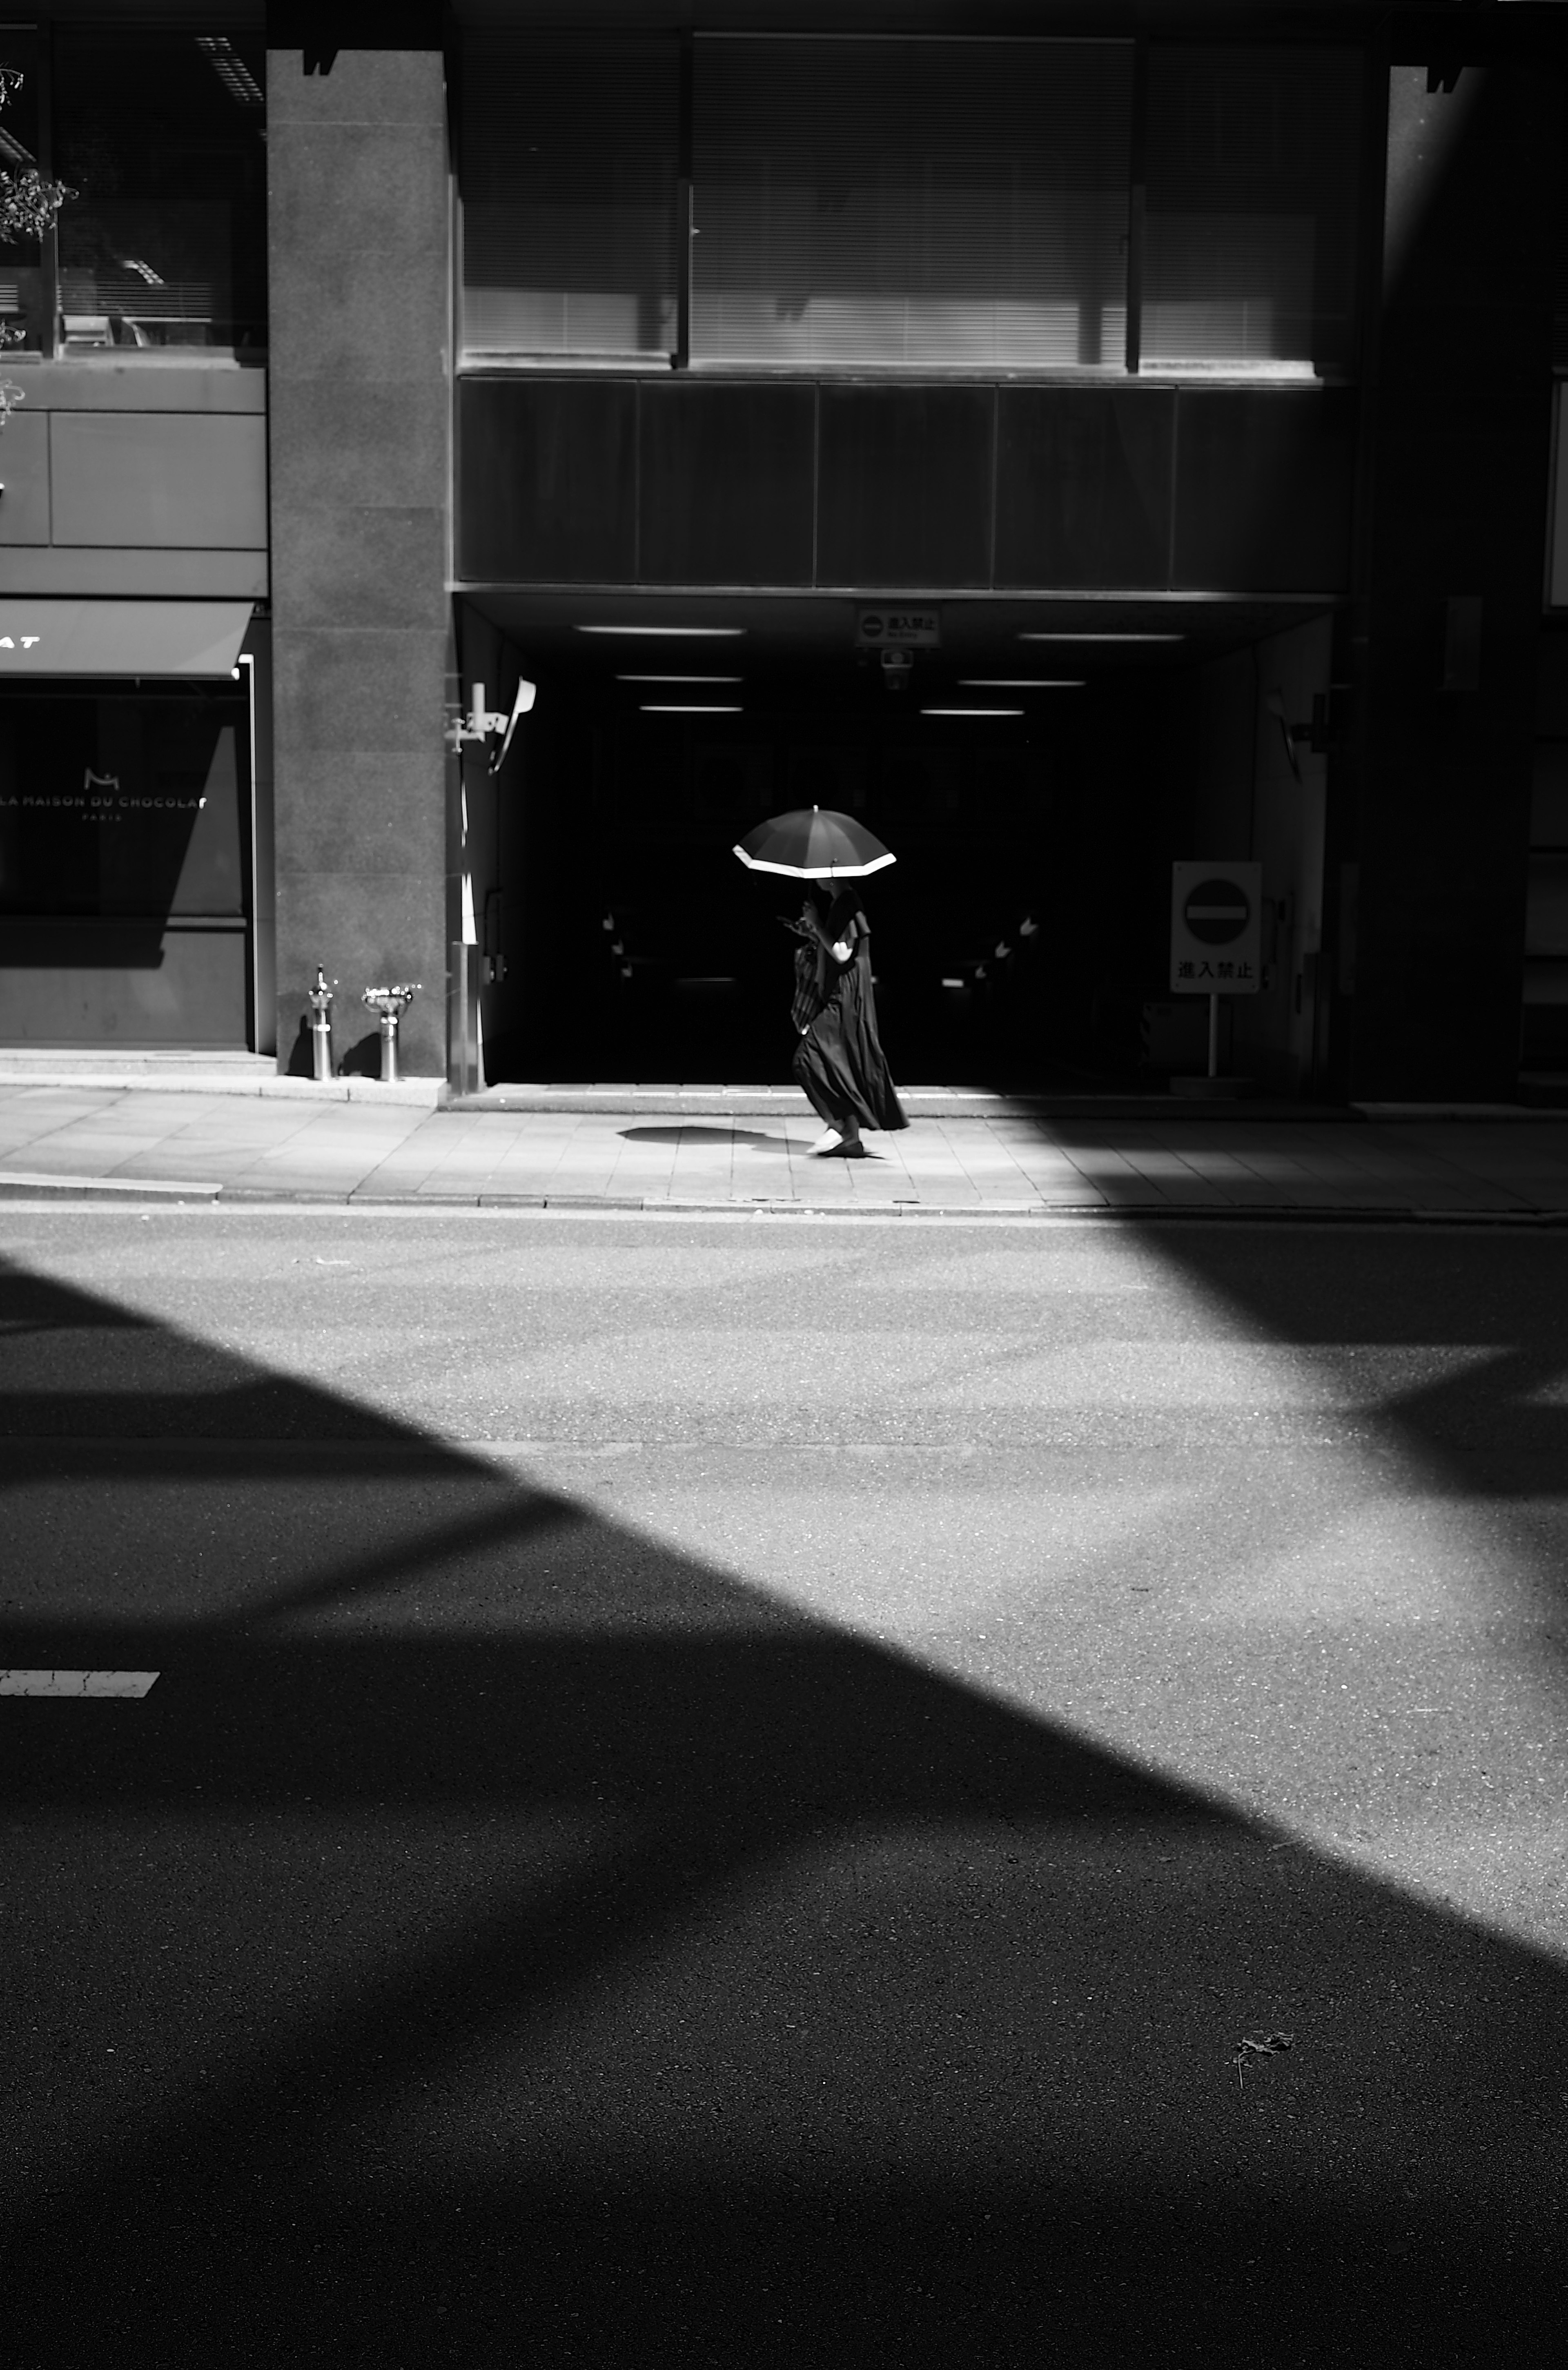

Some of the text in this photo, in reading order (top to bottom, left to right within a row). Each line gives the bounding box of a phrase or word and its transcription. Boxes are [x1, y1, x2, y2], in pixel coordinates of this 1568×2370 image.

[888, 617, 935, 630] 進入禁止
[0, 796, 19, 806] LA
[22, 796, 85, 807] MAISON
[90, 796, 113, 807] DU
[82, 813, 122, 822] PARIS
[1178, 961, 1253, 979] 進入禁止
